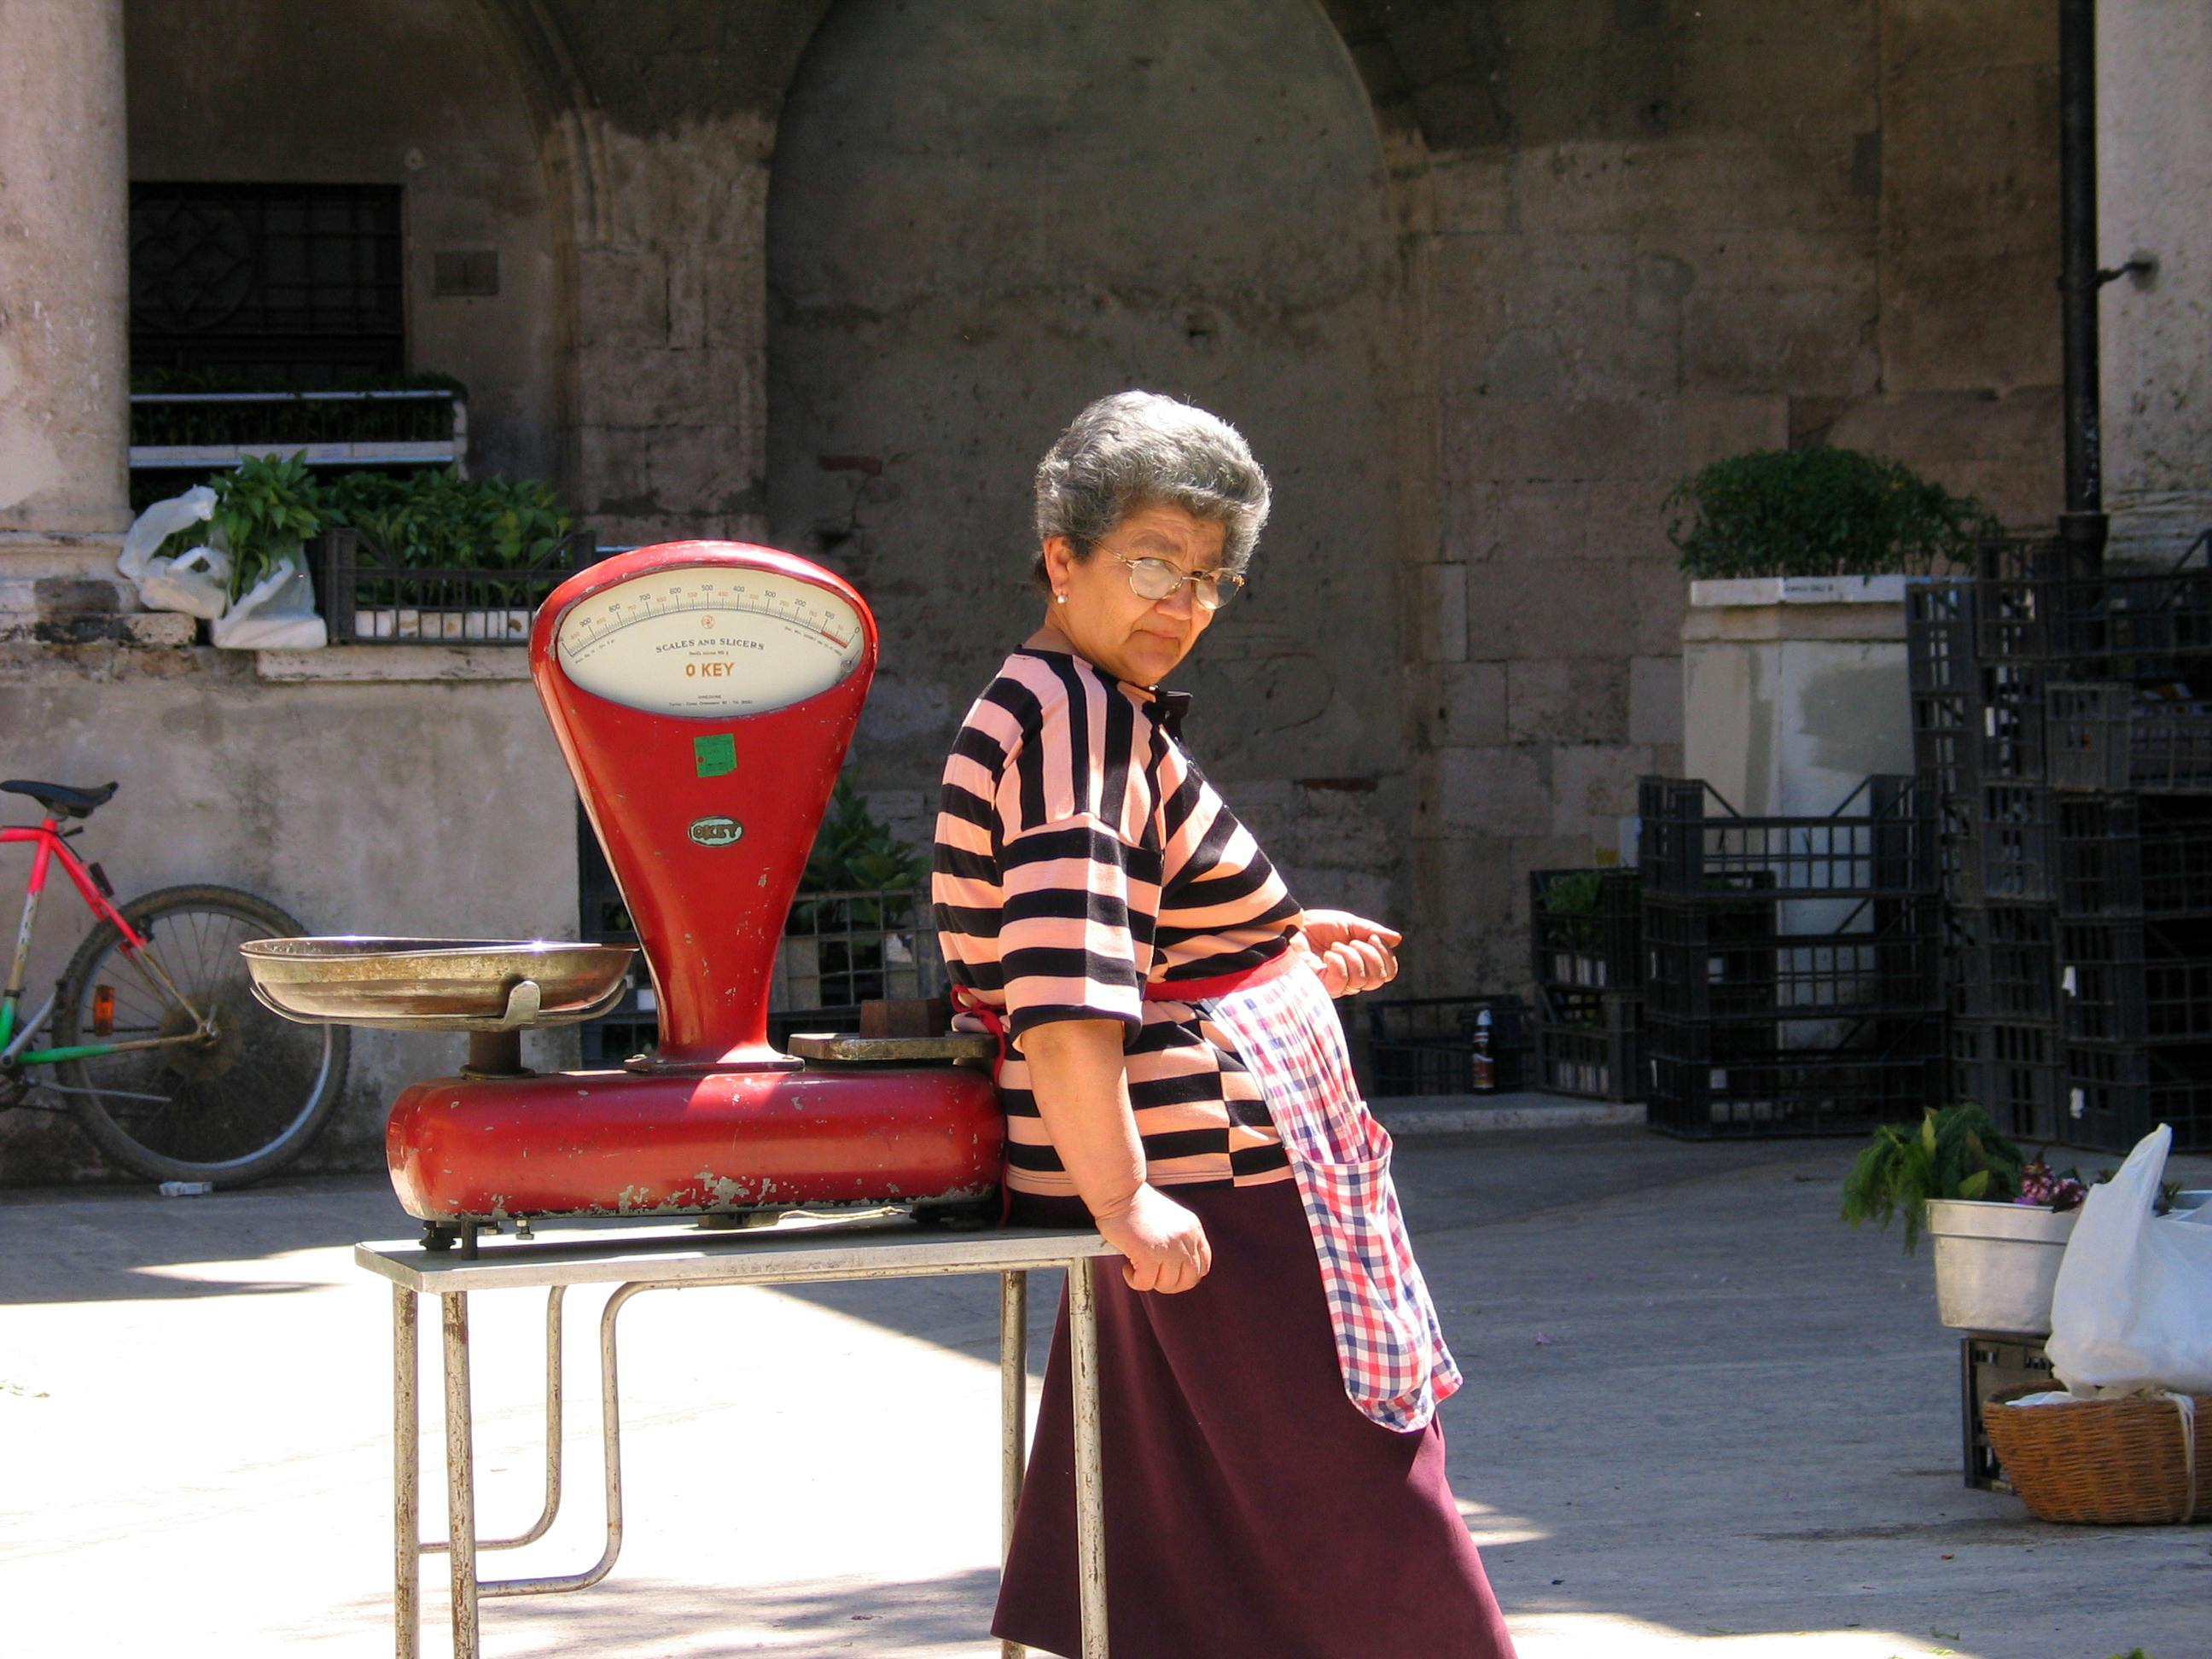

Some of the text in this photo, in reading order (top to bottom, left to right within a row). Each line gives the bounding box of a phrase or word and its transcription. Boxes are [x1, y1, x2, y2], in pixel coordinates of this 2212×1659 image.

[655, 639, 696, 654] SCALES
[719, 637, 765, 650] SLICERS
[685, 662, 735, 677] O KEY
